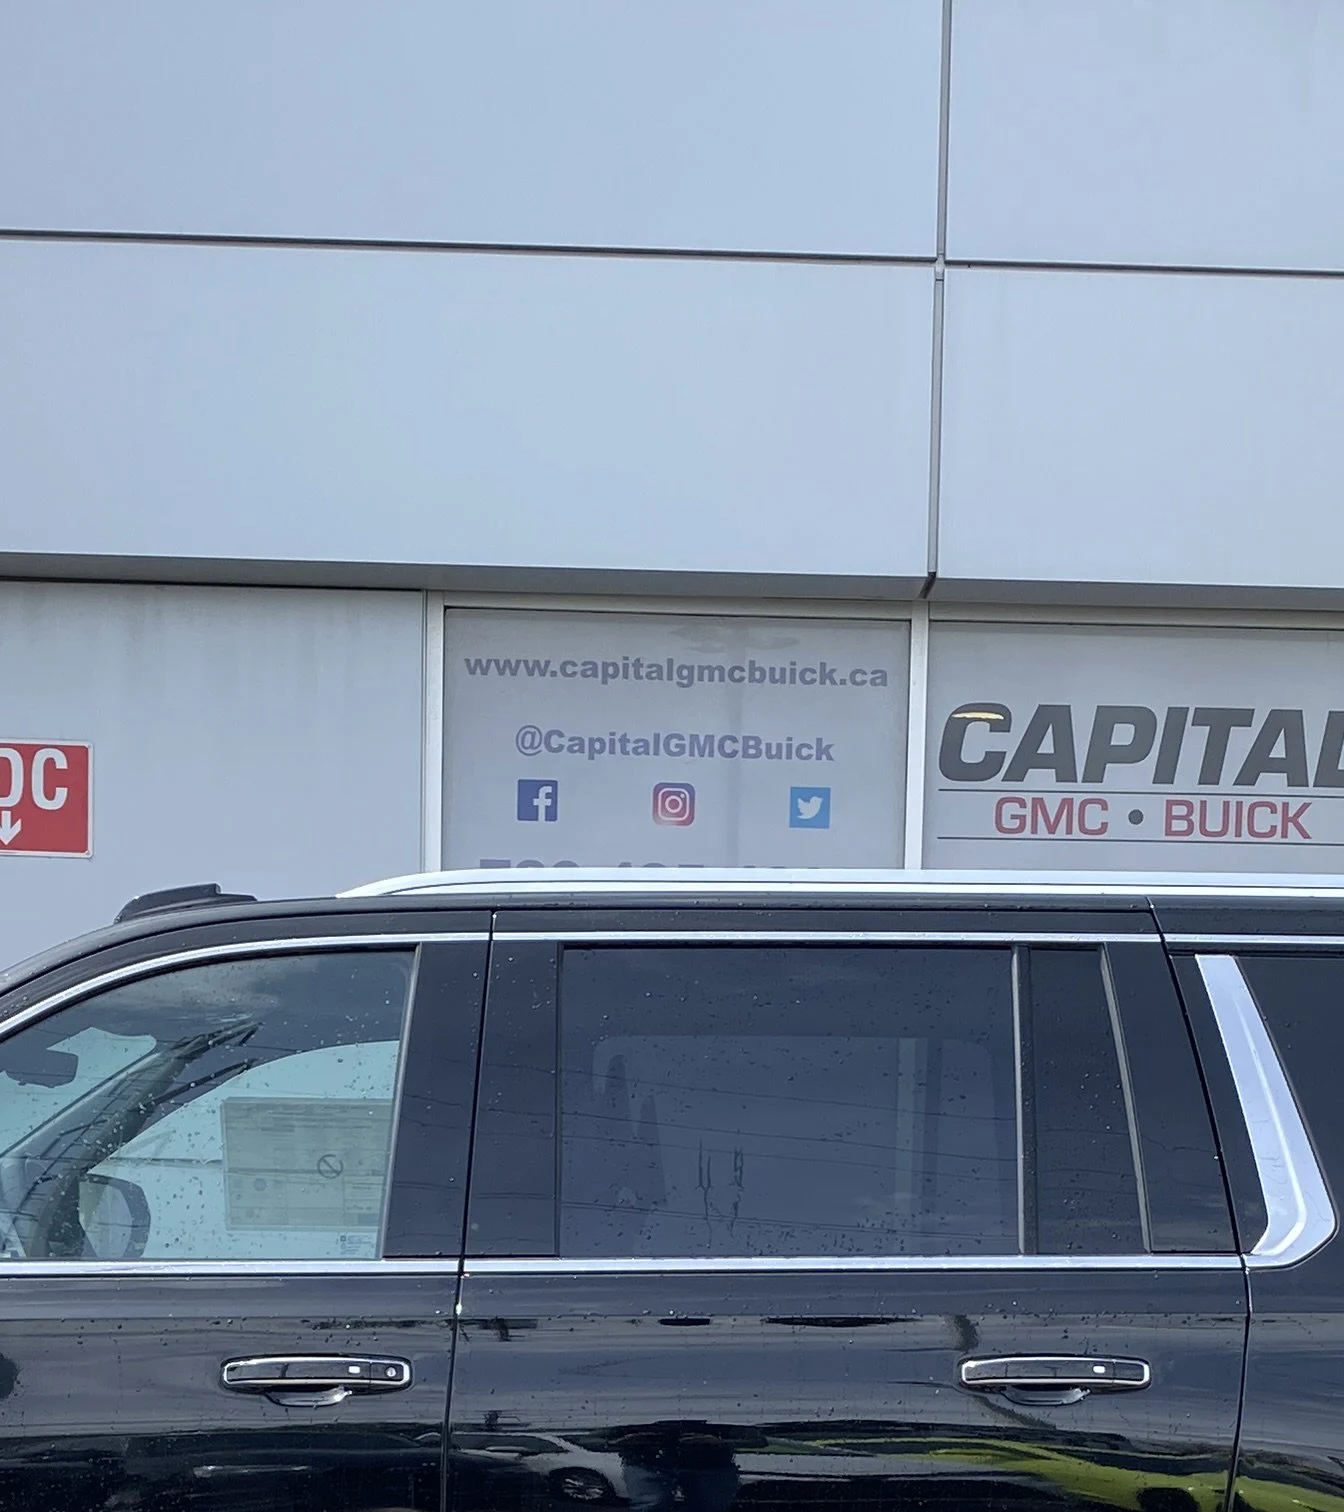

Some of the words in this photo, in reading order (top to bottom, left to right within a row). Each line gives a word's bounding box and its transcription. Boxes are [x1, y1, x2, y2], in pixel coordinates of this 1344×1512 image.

[463, 656, 889, 689] www.capitalgmcbuick.ca
[515, 724, 835, 762] @CapitalGMCBuick
[994, 796, 1109, 836] GMC
[1164, 799, 1313, 840] BUICK
